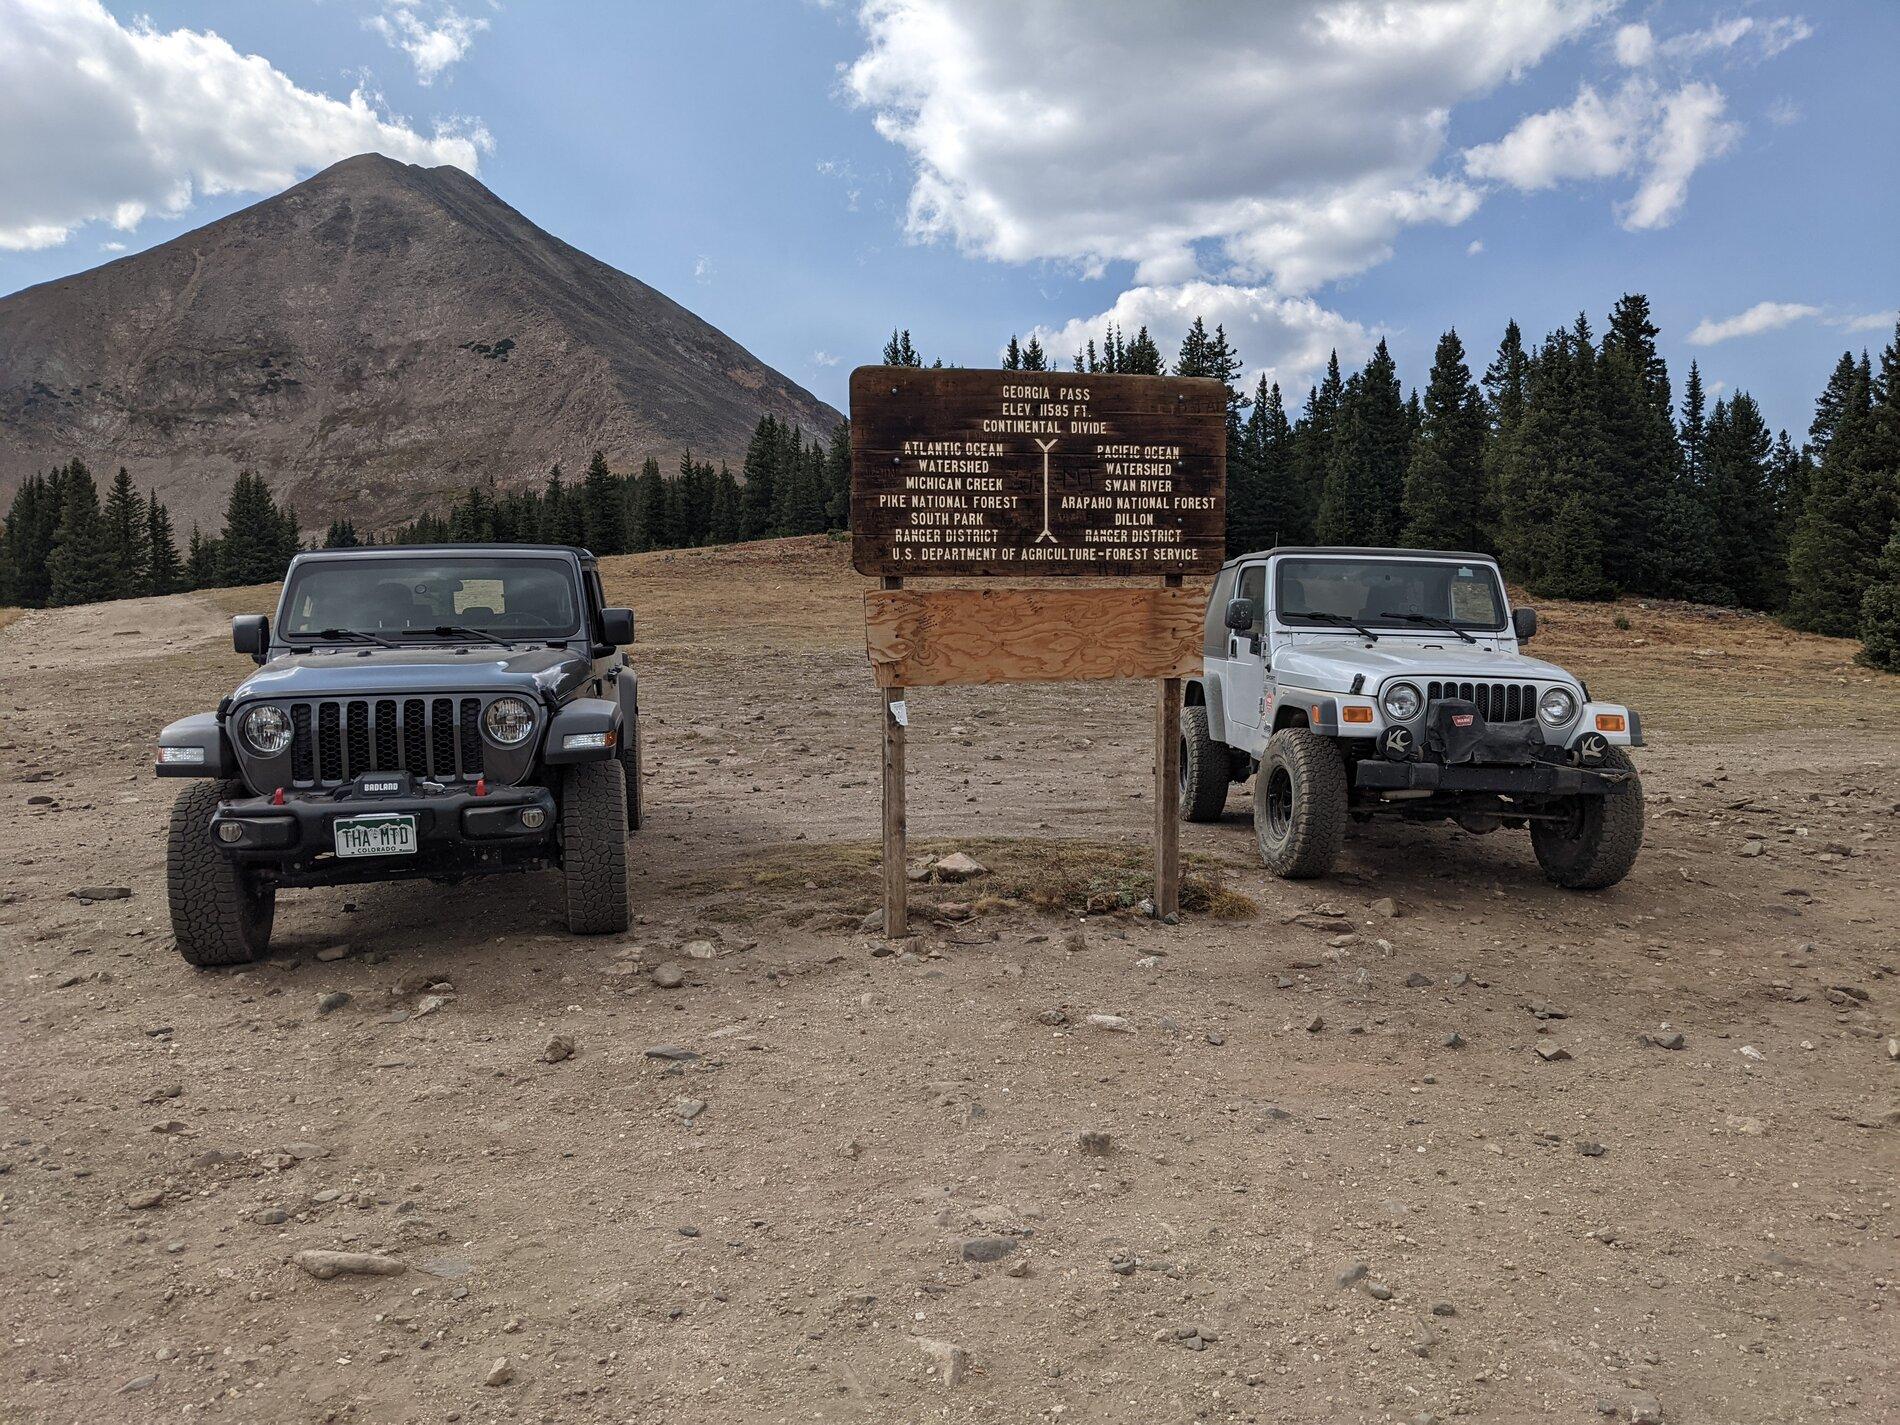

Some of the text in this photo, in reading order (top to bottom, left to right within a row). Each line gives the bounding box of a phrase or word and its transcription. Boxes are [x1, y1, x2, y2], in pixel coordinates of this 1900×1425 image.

[1003, 386, 1089, 400] GEORGIA PASS
[1003, 403, 1092, 417] ELEV. 11585 FT.
[984, 420, 1106, 434] CONTINENTAL DIVIDE
[905, 442, 1002, 456] ATLANTIC OCEAN
[1098, 445, 1178, 459] PACIFIC OCEAN
[919, 460, 988, 473] WATERSHED
[1106, 463, 1171, 475] WATERSHED
[907, 477, 1002, 490] MICHIGAN CREEK
[1106, 480, 1171, 492] SWAN RIVER
[880, 495, 1017, 508] PIKE NATIONAL FOREST
[1062, 497, 1215, 509] ARAPAHO NATIONAL FOREST
[912, 513, 983, 525] SOUTH PARK
[1116, 514, 1153, 525] DILLON
[896, 529, 998, 542] RANGER DISTRICT
[1086, 530, 1181, 542] RANGER DISTRICT
[893, 548, 916, 560] U.S.
[922, 548, 996, 560] DEPARTMENT
[1002, 548, 1015, 560] OF
[1154, 549, 1198, 560] SERVICE
[1386, 730, 1411, 752] KC
[1582, 736, 1605, 760] KC
[364, 783, 399, 791] BADLAND
